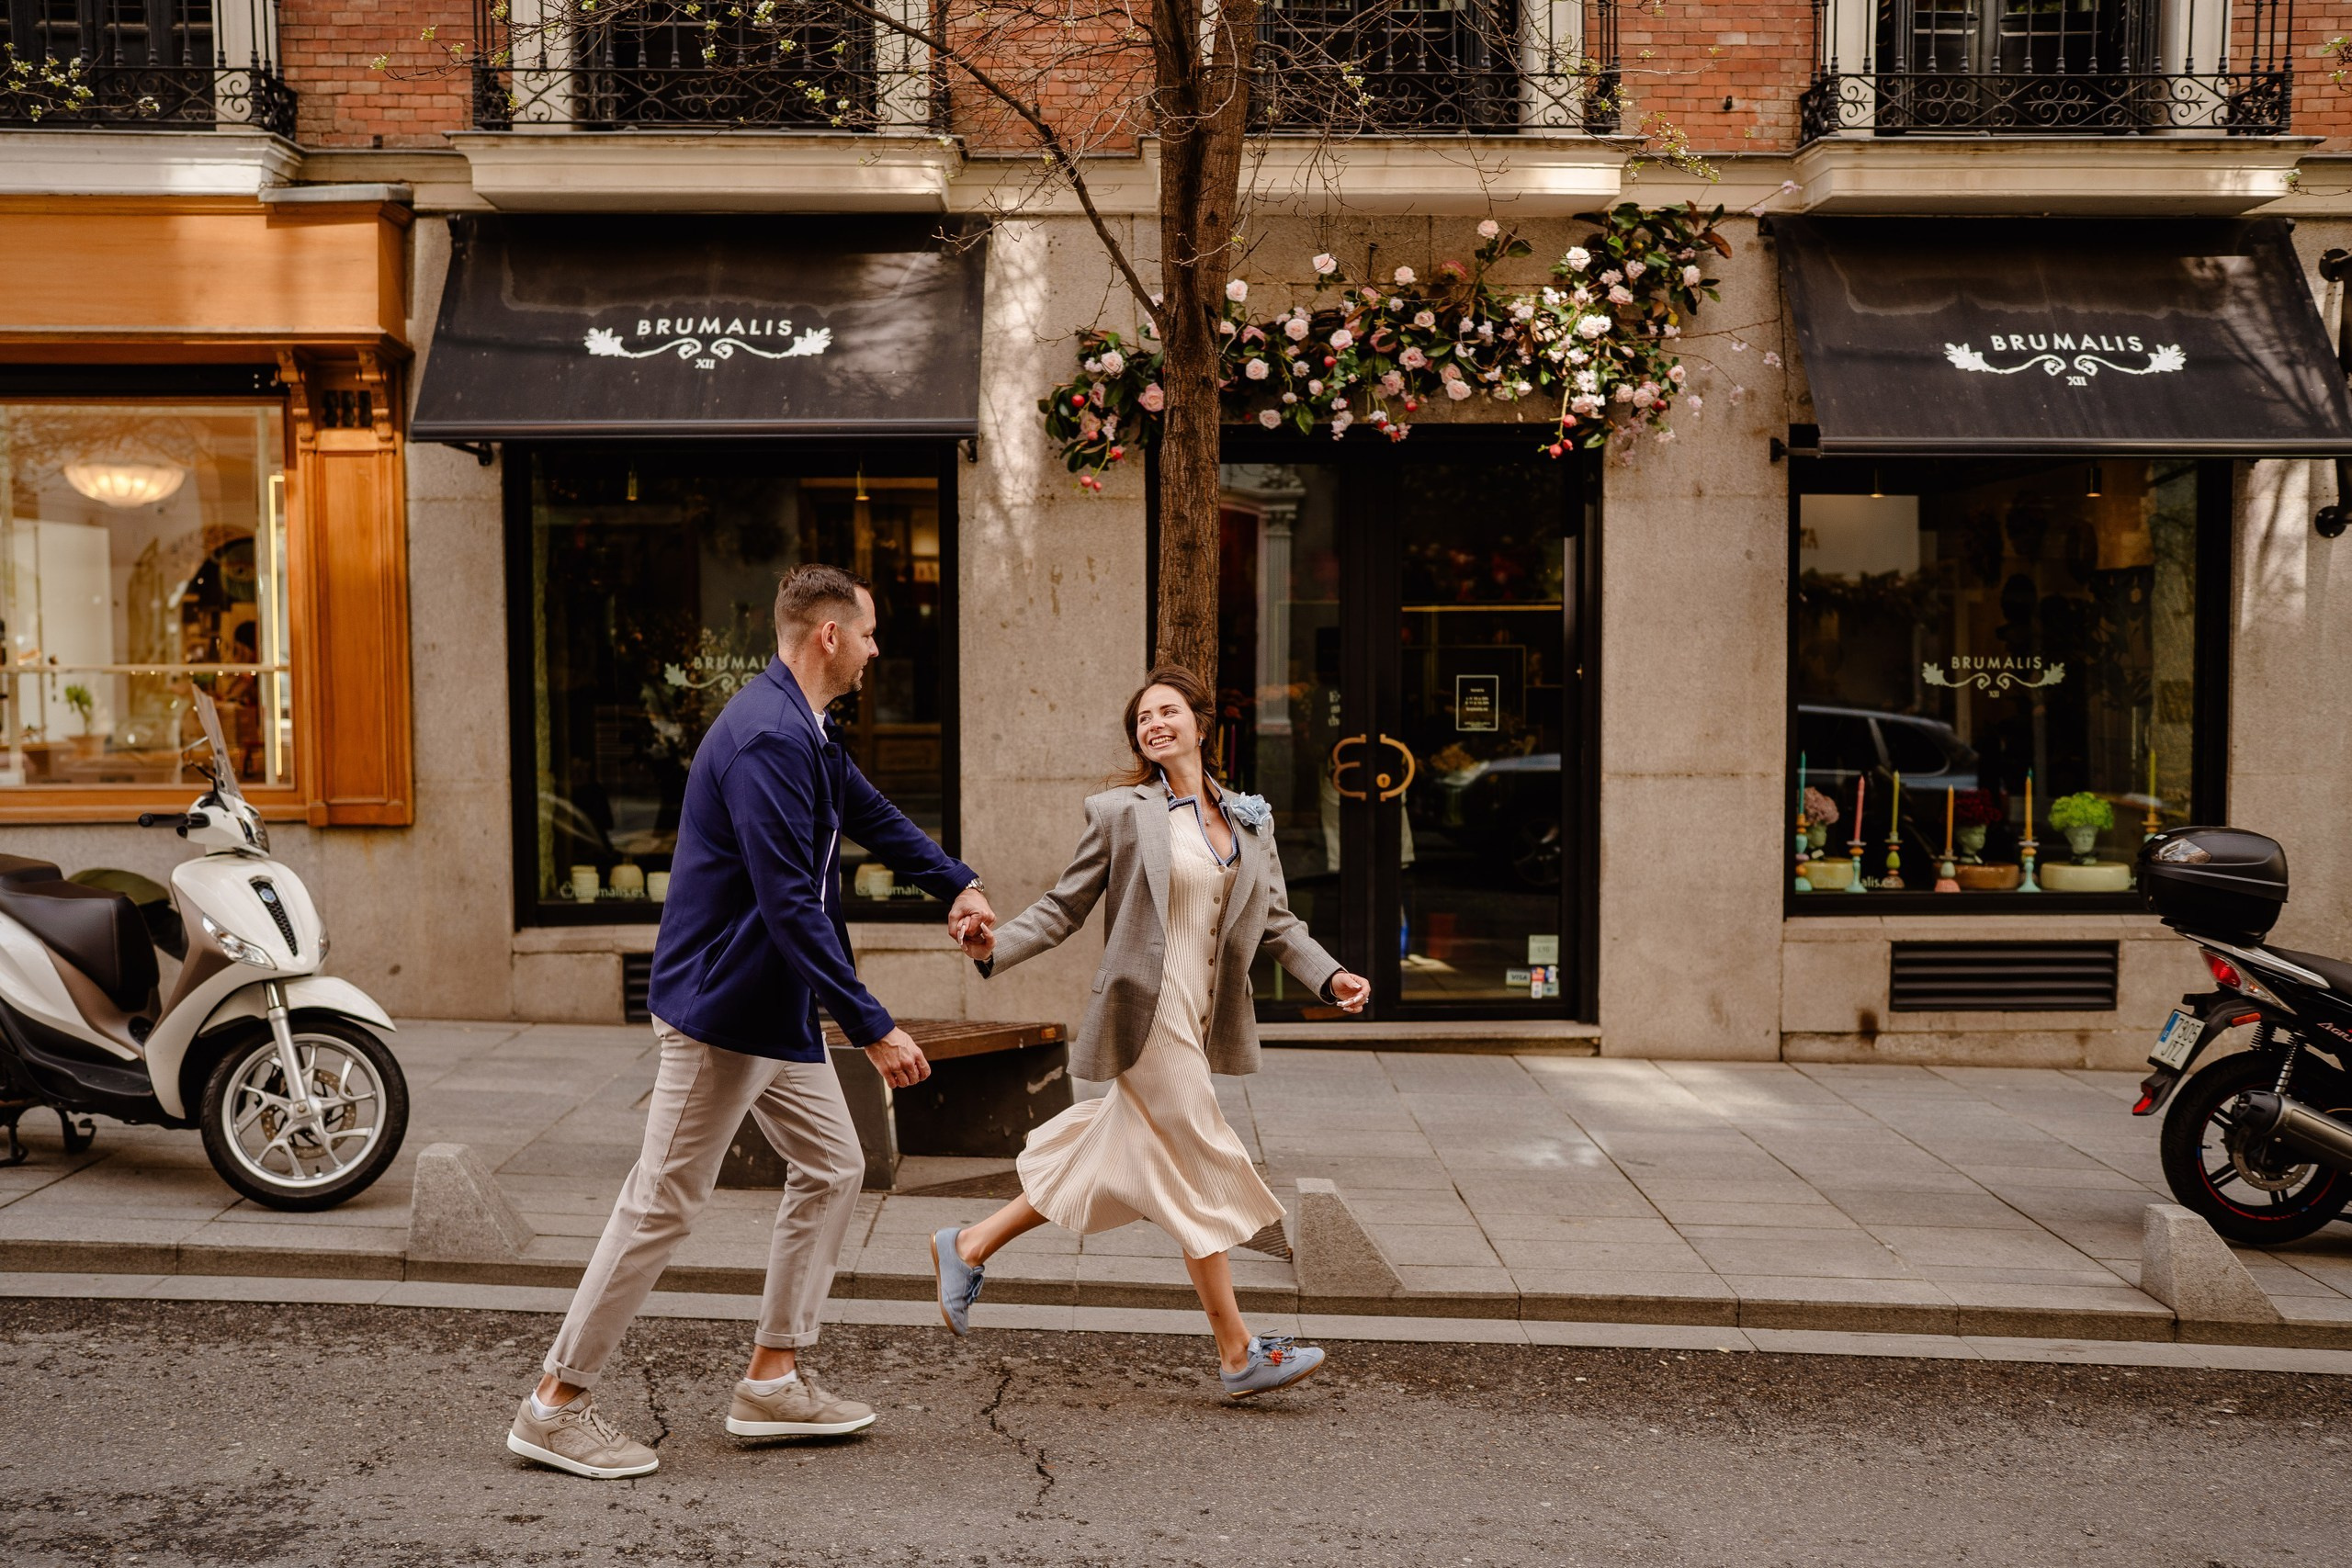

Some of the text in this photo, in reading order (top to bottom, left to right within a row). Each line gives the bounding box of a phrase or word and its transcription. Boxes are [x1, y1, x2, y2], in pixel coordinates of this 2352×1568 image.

[636, 317, 794, 336] BRUMALIS
[1990, 333, 2143, 352] BRUMALIS
[695, 357, 715, 369] XII
[2066, 376, 2087, 386] XII
[694, 655, 769, 671] BRUMAL
[1951, 656, 2042, 670] BRUMALIS
[2171, 1018, 2201, 1043] 7305
[2161, 1040, 2185, 1062] JTZ
